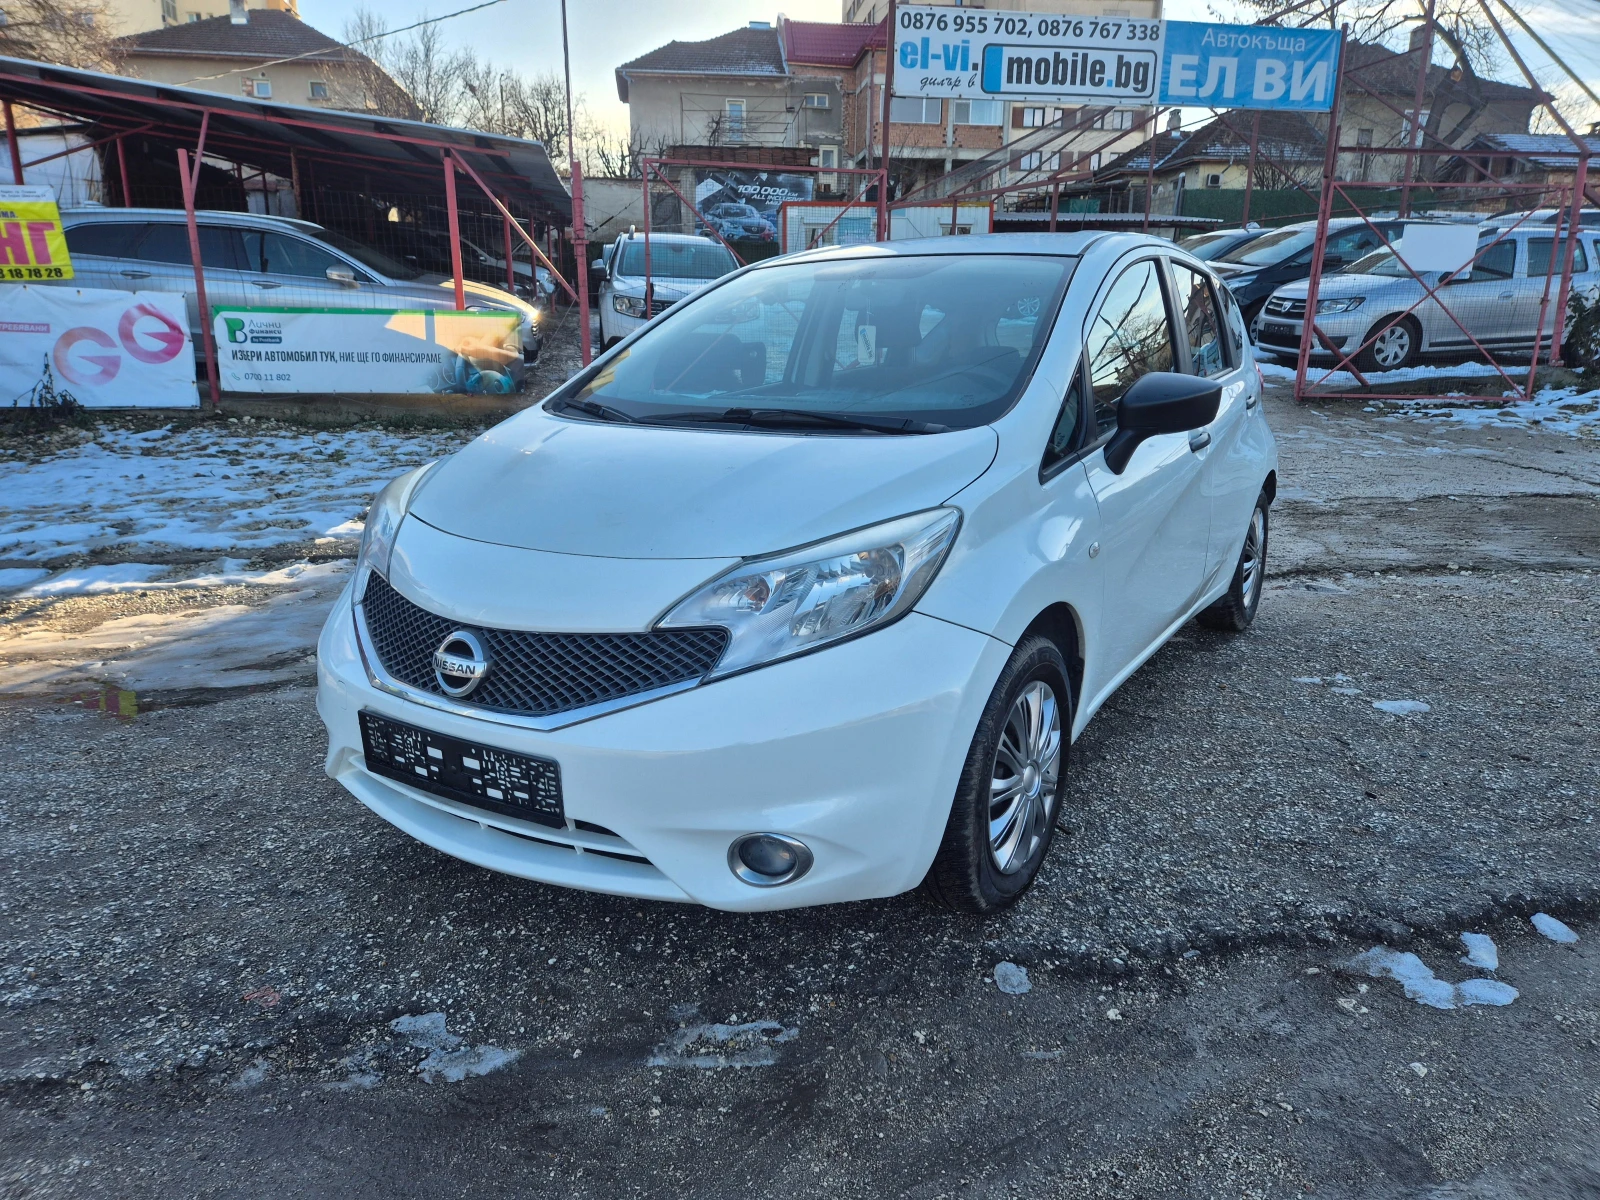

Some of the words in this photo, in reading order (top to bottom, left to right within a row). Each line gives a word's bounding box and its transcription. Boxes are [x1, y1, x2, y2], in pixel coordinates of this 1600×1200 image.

[900, 11, 949, 31] 0876
[953, 15, 988, 34] 955
[994, 17, 1033, 38] 702,
[1037, 19, 1084, 38] 0876
[1089, 21, 1122, 40] 767
[1126, 24, 1160, 41] 338
[1201, 28, 1306, 55] Автокъща
[1006, 51, 1150, 93] mobile.bg
[1167, 54, 1239, 99] ЕЛ
[1252, 58, 1328, 102] ВИ
[919, 76, 962, 91] дилър
[967, 73, 978, 88] в
[737, 185, 760, 194] 100
[760, 186, 788, 196] 000
[7, 268, 24, 279] 18
[25, 268, 43, 279] 78
[44, 267, 64, 278] 28
[248, 319, 282, 329] Лични
[231, 349, 262, 362] ИЗБЕРИ
[264, 350, 318, 362] АВТОМОБИЛ
[319, 351, 338, 363] ТУК,
[339, 351, 355, 363] НИЕ
[356, 352, 369, 365] ЩЕ
[371, 352, 381, 363] ГО
[382, 352, 442, 364] ФИНАНСИРАМЕ
[244, 372, 262, 381] 0700
[264, 373, 273, 381] 11
[275, 373, 291, 381] 802
[433, 655, 476, 675] NISSAN
